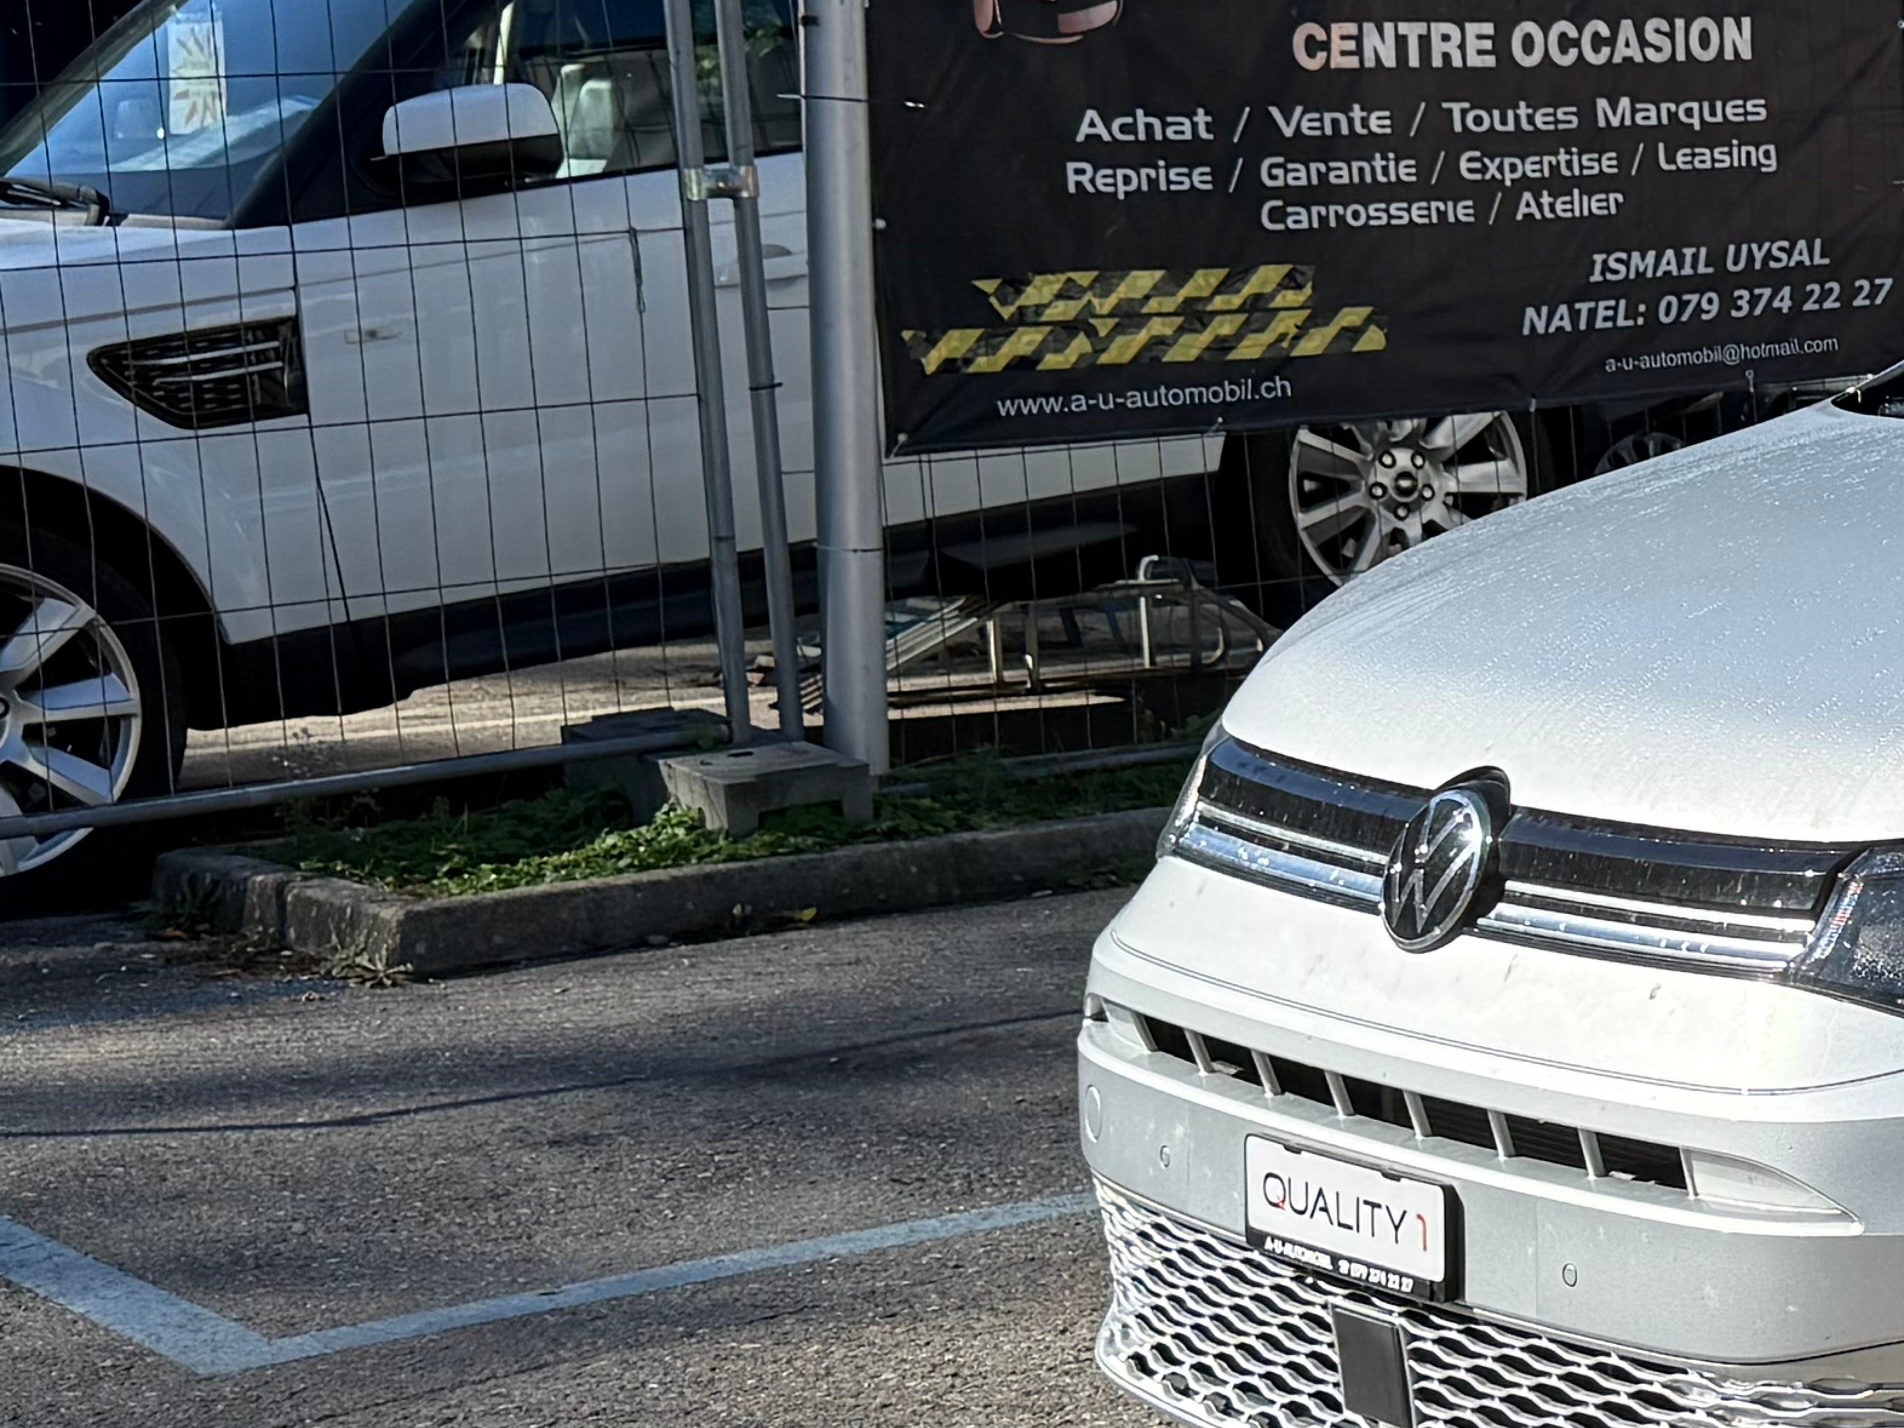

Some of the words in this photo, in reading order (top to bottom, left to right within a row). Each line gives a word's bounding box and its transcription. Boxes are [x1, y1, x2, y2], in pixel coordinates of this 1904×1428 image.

[1292, 21, 1497, 71] CENTRE
[1511, 16, 1752, 68] OCCASION
[1076, 107, 1214, 143] Achat
[1267, 103, 1392, 138] Vente
[1441, 101, 1579, 133] Toutes
[1595, 97, 1767, 131] Marques
[1066, 159, 1213, 200] Reprise
[1260, 152, 1417, 188] Garantie
[1459, 147, 1619, 186] Expertise
[1657, 139, 1777, 173] Leasing
[1261, 197, 1475, 232] Carrosserie
[1515, 188, 1624, 221] Atelier
[1588, 246, 1714, 283] ISMAIL
[1726, 238, 1830, 273] UYSAL
[1521, 298, 1646, 336] NATEL:
[1657, 291, 1720, 324] 079
[1730, 285, 1792, 318] 374
[1801, 280, 1841, 312] 22
[1852, 277, 1893, 307] 27
[1605, 335, 1839, 373] a-u-automobil@hotmail.com
[997, 375, 1292, 417] www.a-u-automobil.ch
